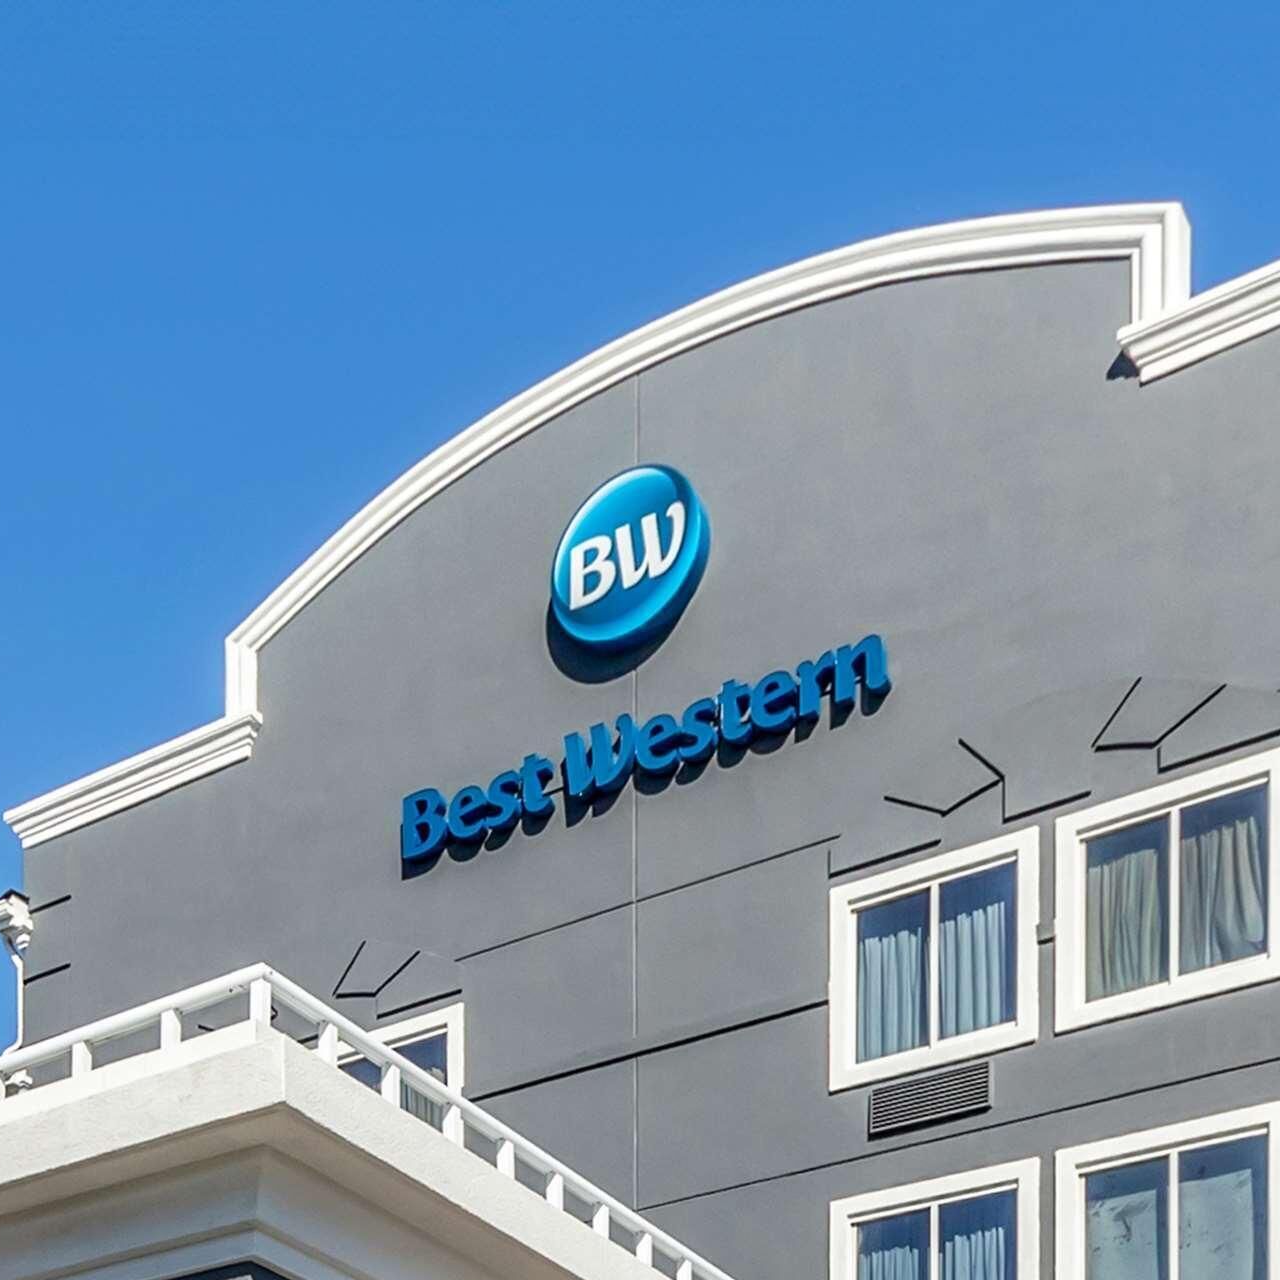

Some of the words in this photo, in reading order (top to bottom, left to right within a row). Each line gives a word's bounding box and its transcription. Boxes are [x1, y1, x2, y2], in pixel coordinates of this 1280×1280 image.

[569, 501, 686, 611] BW
[401, 753, 555, 862] Best
[563, 634, 891, 799] Western
